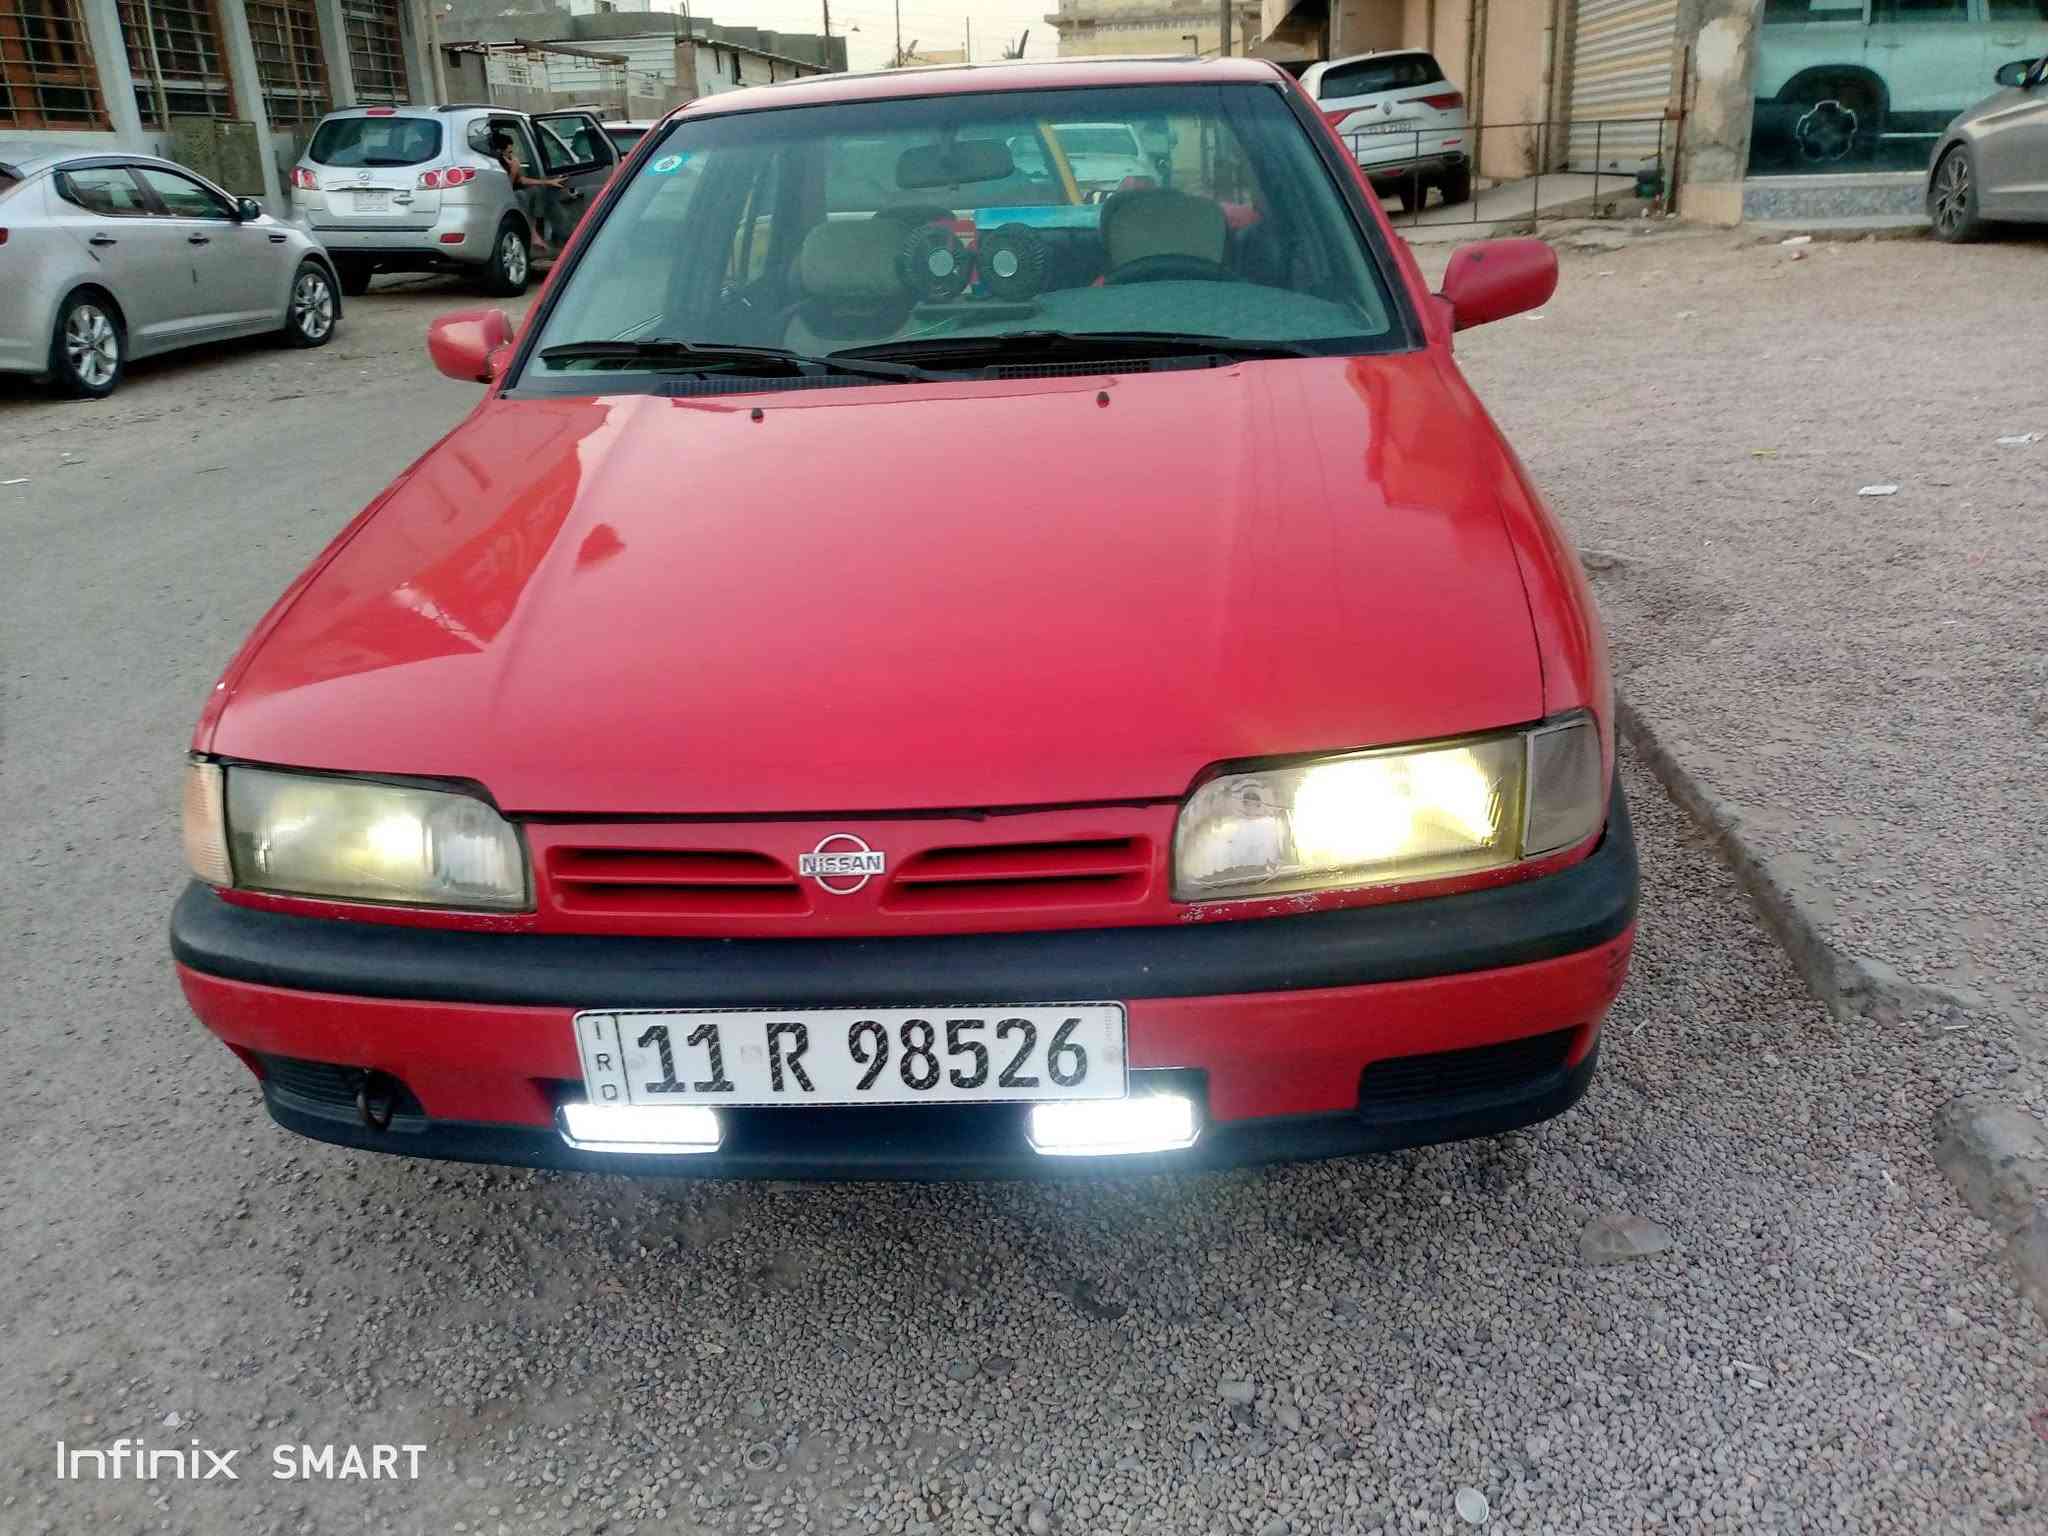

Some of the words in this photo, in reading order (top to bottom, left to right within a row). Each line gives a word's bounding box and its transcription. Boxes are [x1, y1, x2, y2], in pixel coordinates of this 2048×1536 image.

[802, 855, 881, 872] NISSAN
[637, 1023, 735, 1093] 11
[766, 1022, 815, 1092] R
[848, 1018, 1088, 1091] 98526
